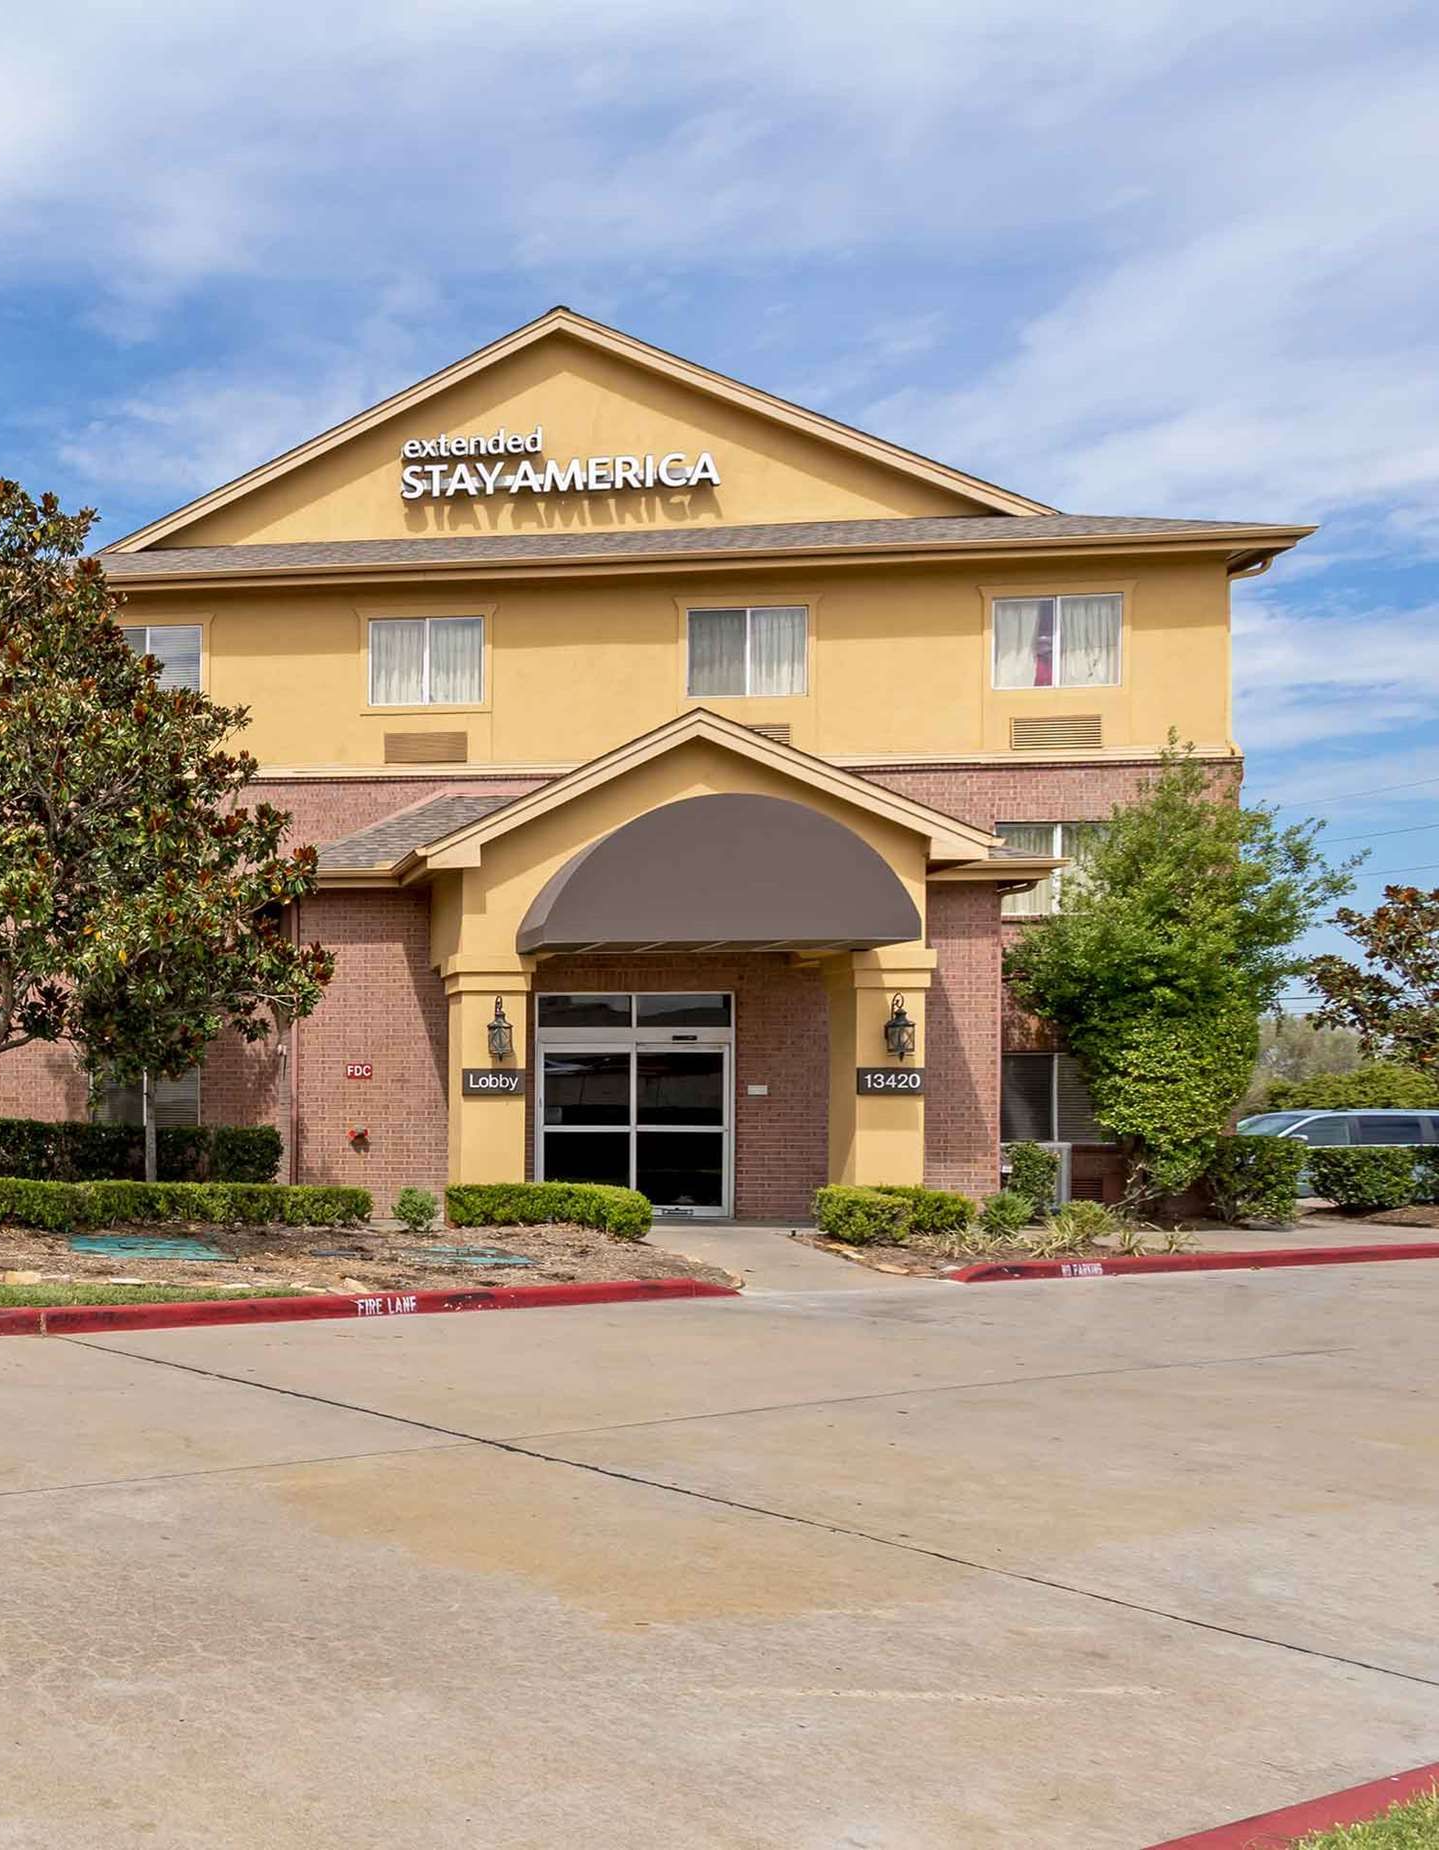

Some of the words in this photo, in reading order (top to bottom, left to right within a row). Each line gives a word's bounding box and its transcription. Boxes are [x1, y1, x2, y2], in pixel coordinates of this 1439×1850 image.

[402, 426, 543, 458] extended
[402, 461, 504, 499] STAY
[511, 452, 721, 495] AMERICA
[347, 1065, 371, 1077] FDC
[469, 1073, 519, 1091] Lobby
[864, 1073, 921, 1089] 13420
[1073, 1263, 1103, 1277] PARKING
[357, 1298, 383, 1316] FIRE
